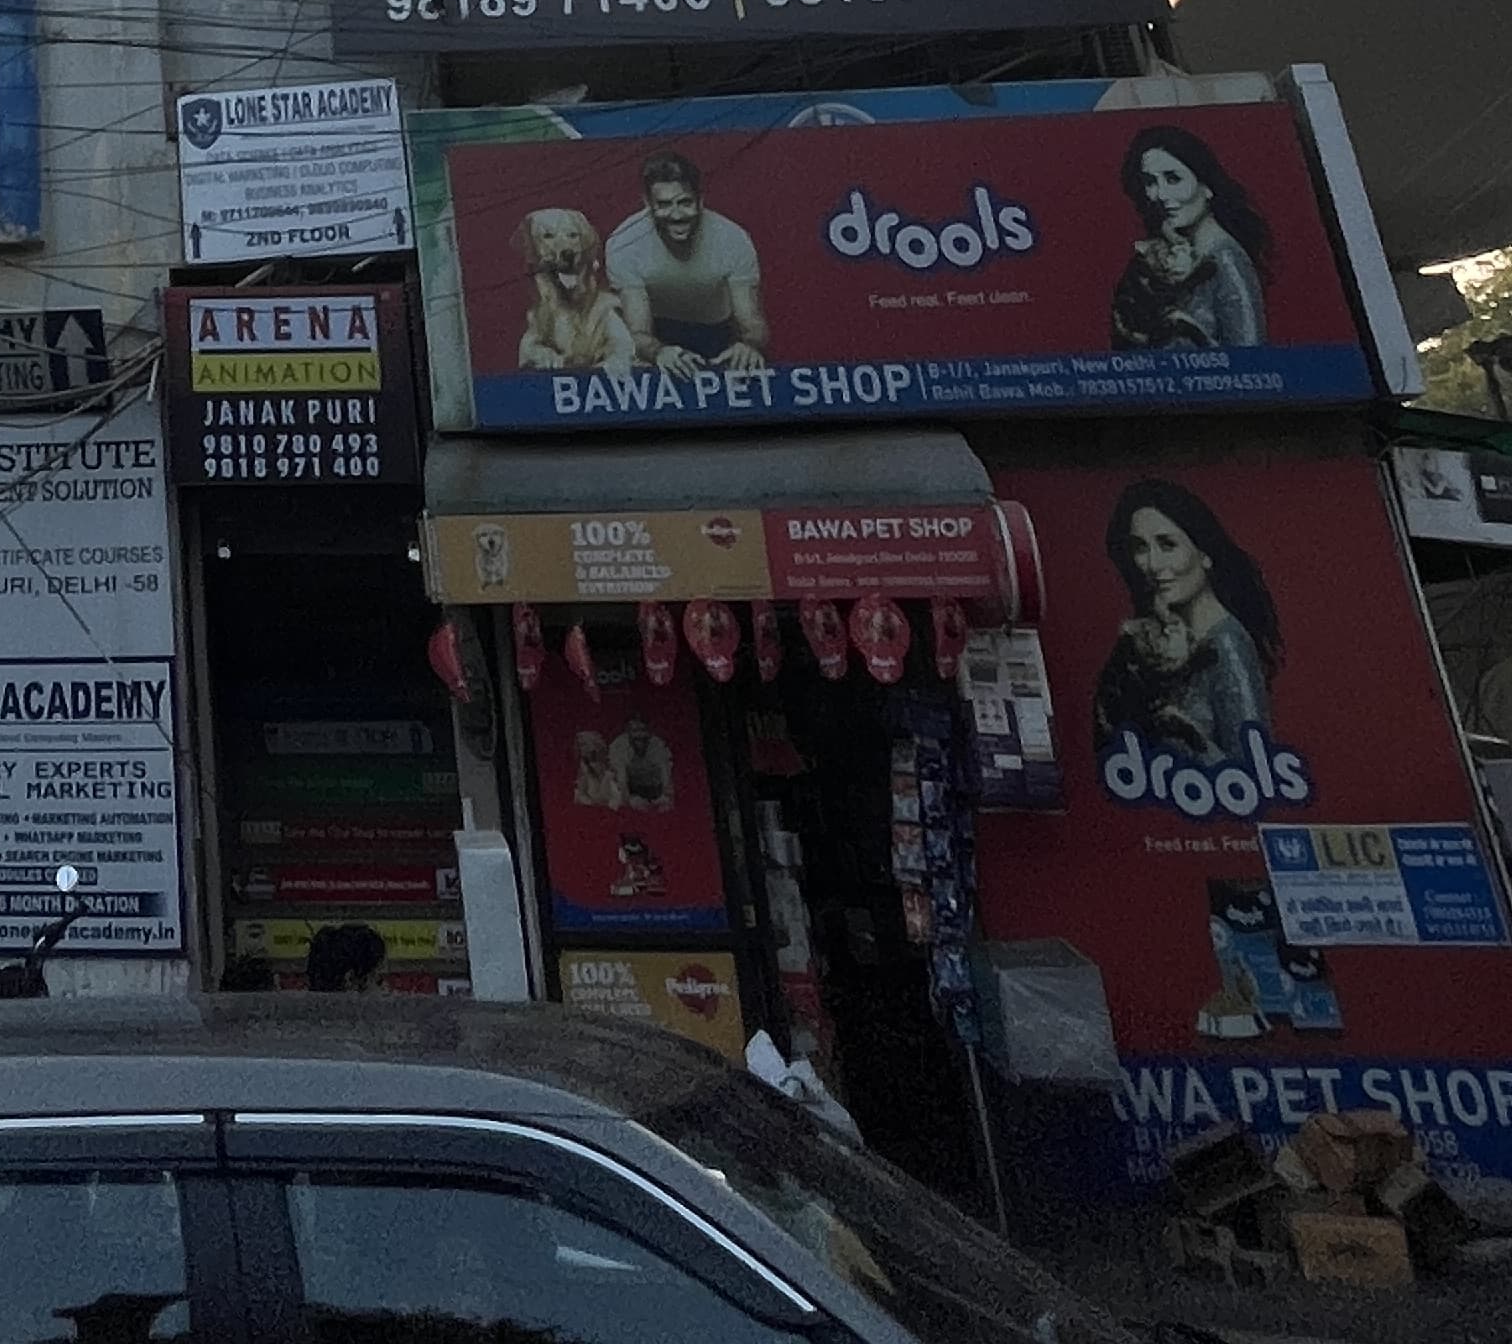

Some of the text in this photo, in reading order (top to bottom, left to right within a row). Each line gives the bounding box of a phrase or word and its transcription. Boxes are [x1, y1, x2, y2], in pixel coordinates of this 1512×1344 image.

[225, 84, 394, 126] LONE STAR ACADEMY
[246, 225, 350, 248] 2ND FLOOR
[828, 188, 1034, 271] drools
[868, 293, 908, 309] Feed
[948, 292, 986, 307] Feed
[198, 305, 370, 342] ARENA
[197, 360, 377, 386] ANIMATION
[1071, 356, 1156, 374] New Delhi
[551, 361, 913, 416] BAWA PET SHOP
[204, 396, 376, 426] JANAK PURI
[331, 433, 378, 454] 493
[277, 457, 380, 478] 971 400
[41, 478, 153, 501] SOLUTION
[570, 520, 651, 546] 100%
[788, 517, 972, 540] BAWA PET SHOP
[80, 546, 163, 564] COURSES
[47, 575, 117, 596] DELHI
[127, 574, 159, 593] -58
[0, 679, 165, 720] ACADEMY
[35, 761, 148, 778] EXPERTS
[1103, 727, 1310, 817] drools
[26, 781, 173, 799] MARKETING
[1320, 830, 1385, 866] LIC
[10, 895, 62, 912] MONTH
[570, 961, 635, 985] 100%
[1232, 1066, 1342, 1124] PET
